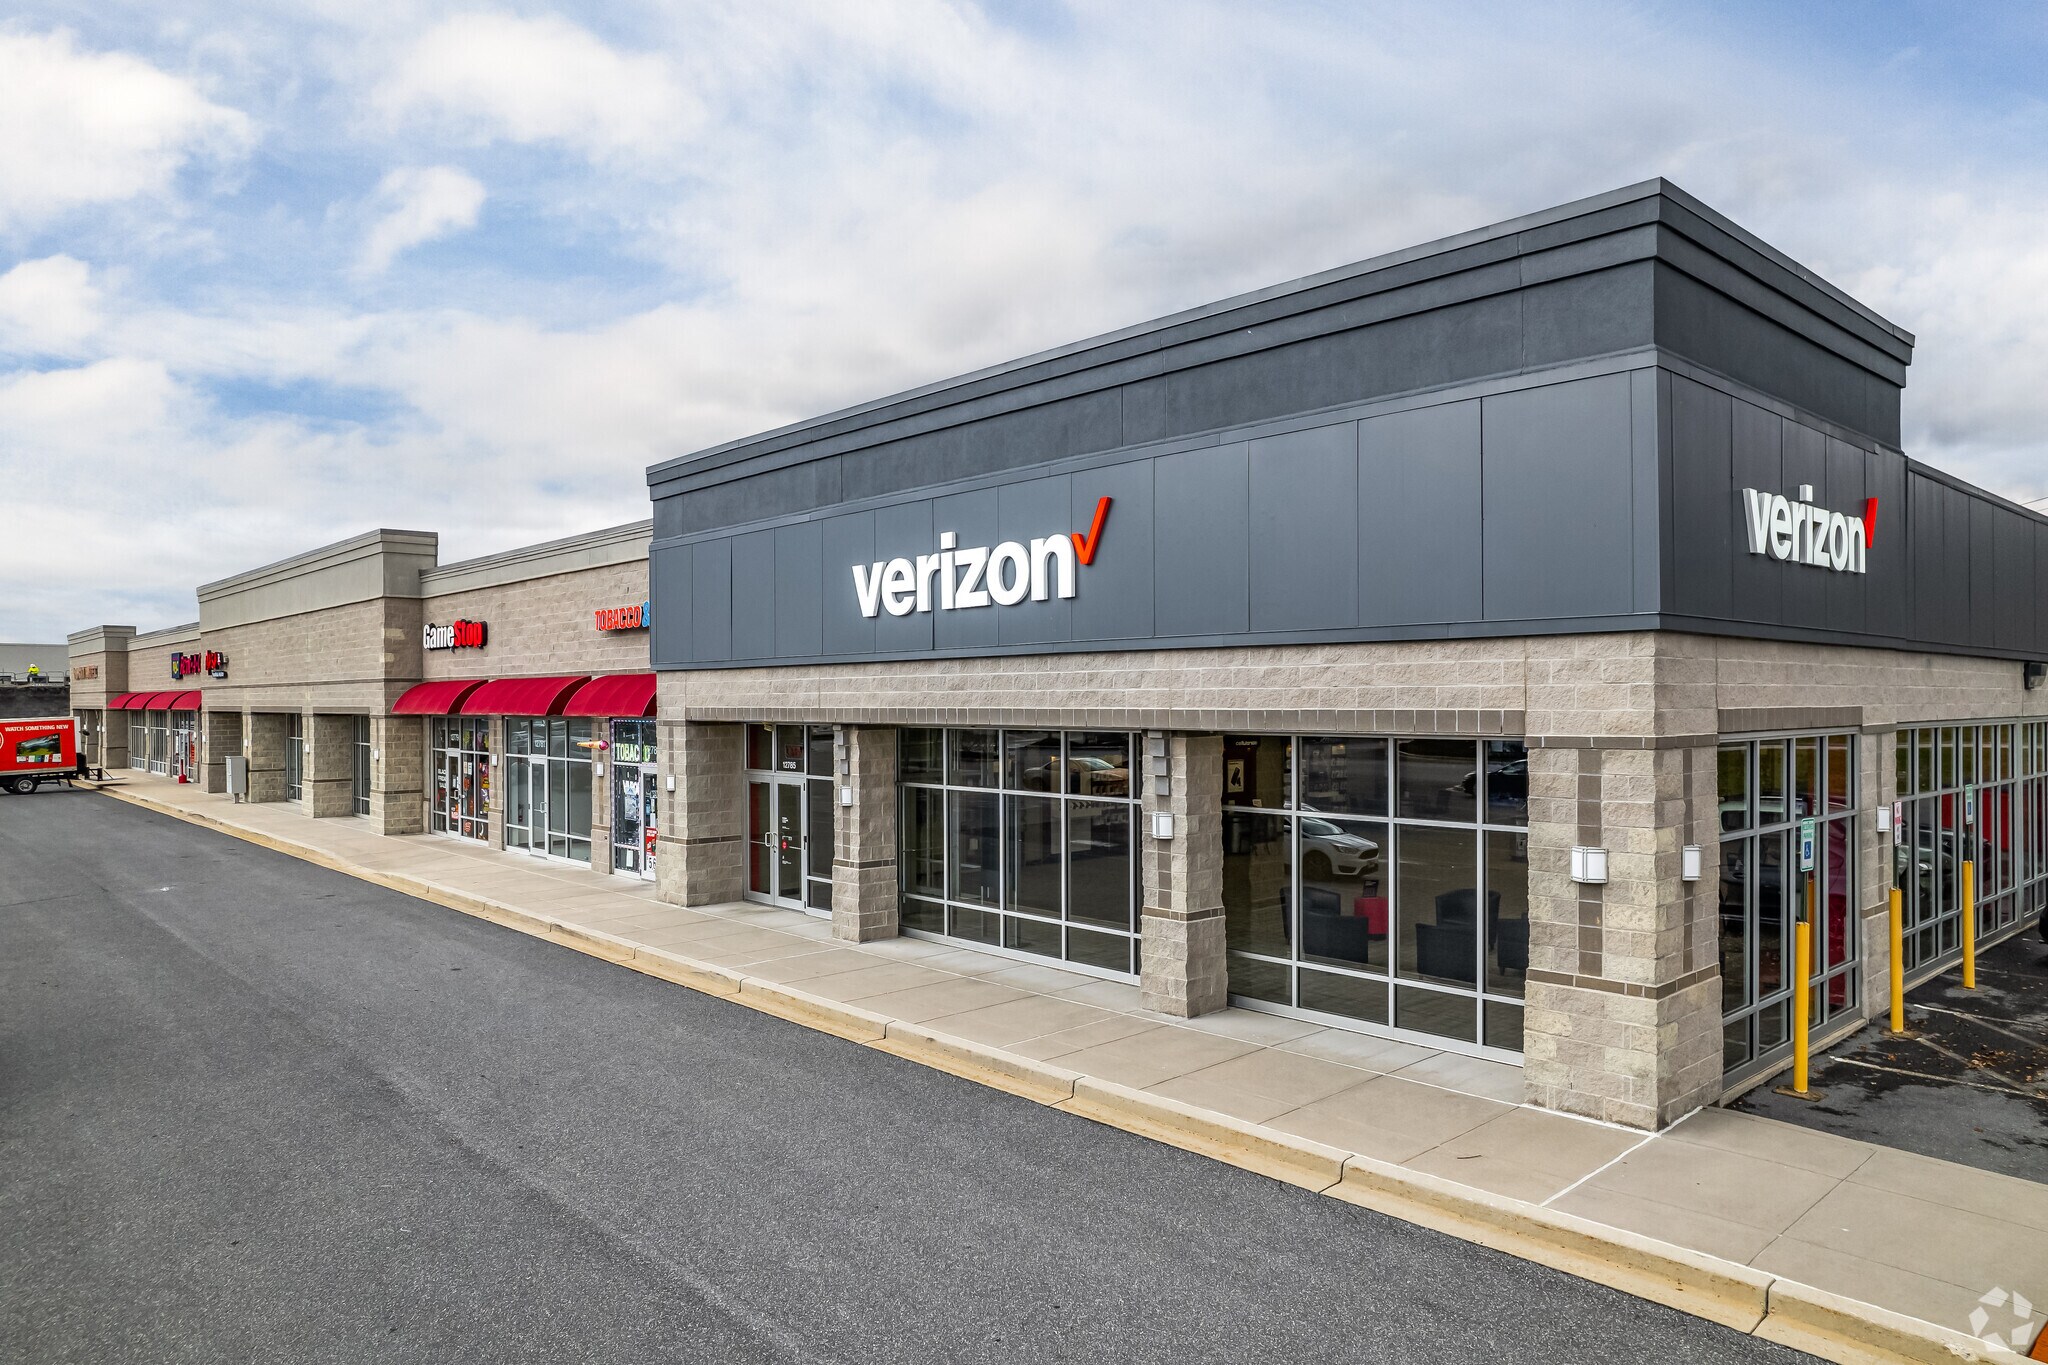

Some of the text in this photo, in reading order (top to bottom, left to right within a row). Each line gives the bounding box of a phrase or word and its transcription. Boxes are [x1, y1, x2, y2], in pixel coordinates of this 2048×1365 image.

[1743, 484, 1866, 574] verizon
[852, 531, 1076, 618] verizon
[423, 620, 484, 649] GameStop
[595, 606, 641, 631] TOBACCO
